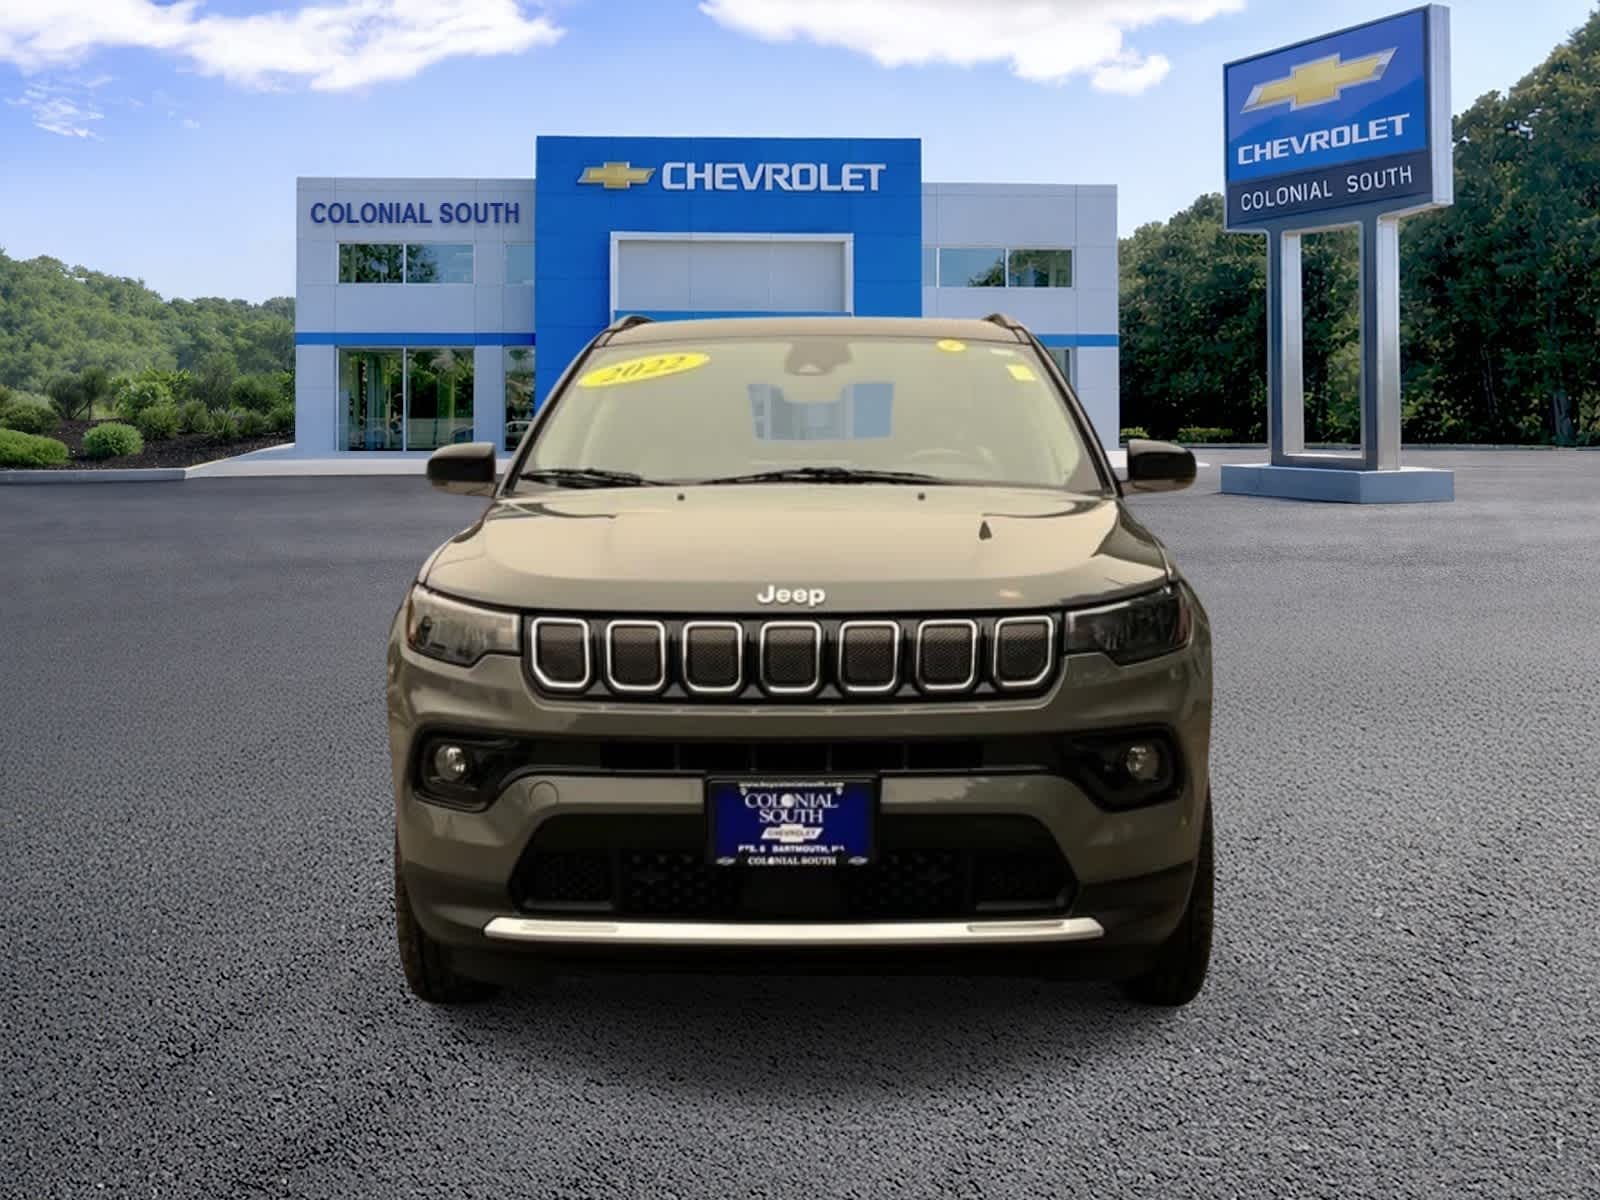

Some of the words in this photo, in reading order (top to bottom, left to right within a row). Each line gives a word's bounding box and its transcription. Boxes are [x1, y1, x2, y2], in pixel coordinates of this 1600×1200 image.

[1237, 112, 1411, 166] CHEVROLET
[661, 161, 888, 192] CHEVROLET
[1240, 180, 1334, 212] COLONIAL
[1346, 164, 1413, 194] SOUTH
[310, 202, 433, 224] COLONIAL
[439, 202, 520, 224] SOUTH
[601, 355, 690, 383] 2022
[756, 584, 826, 607] Jeep
[744, 793, 839, 809] COLONIAL
[759, 809, 823, 823] SOUTH
[747, 856, 801, 865] COLONIAL
[801, 856, 837, 865] SOUTH
